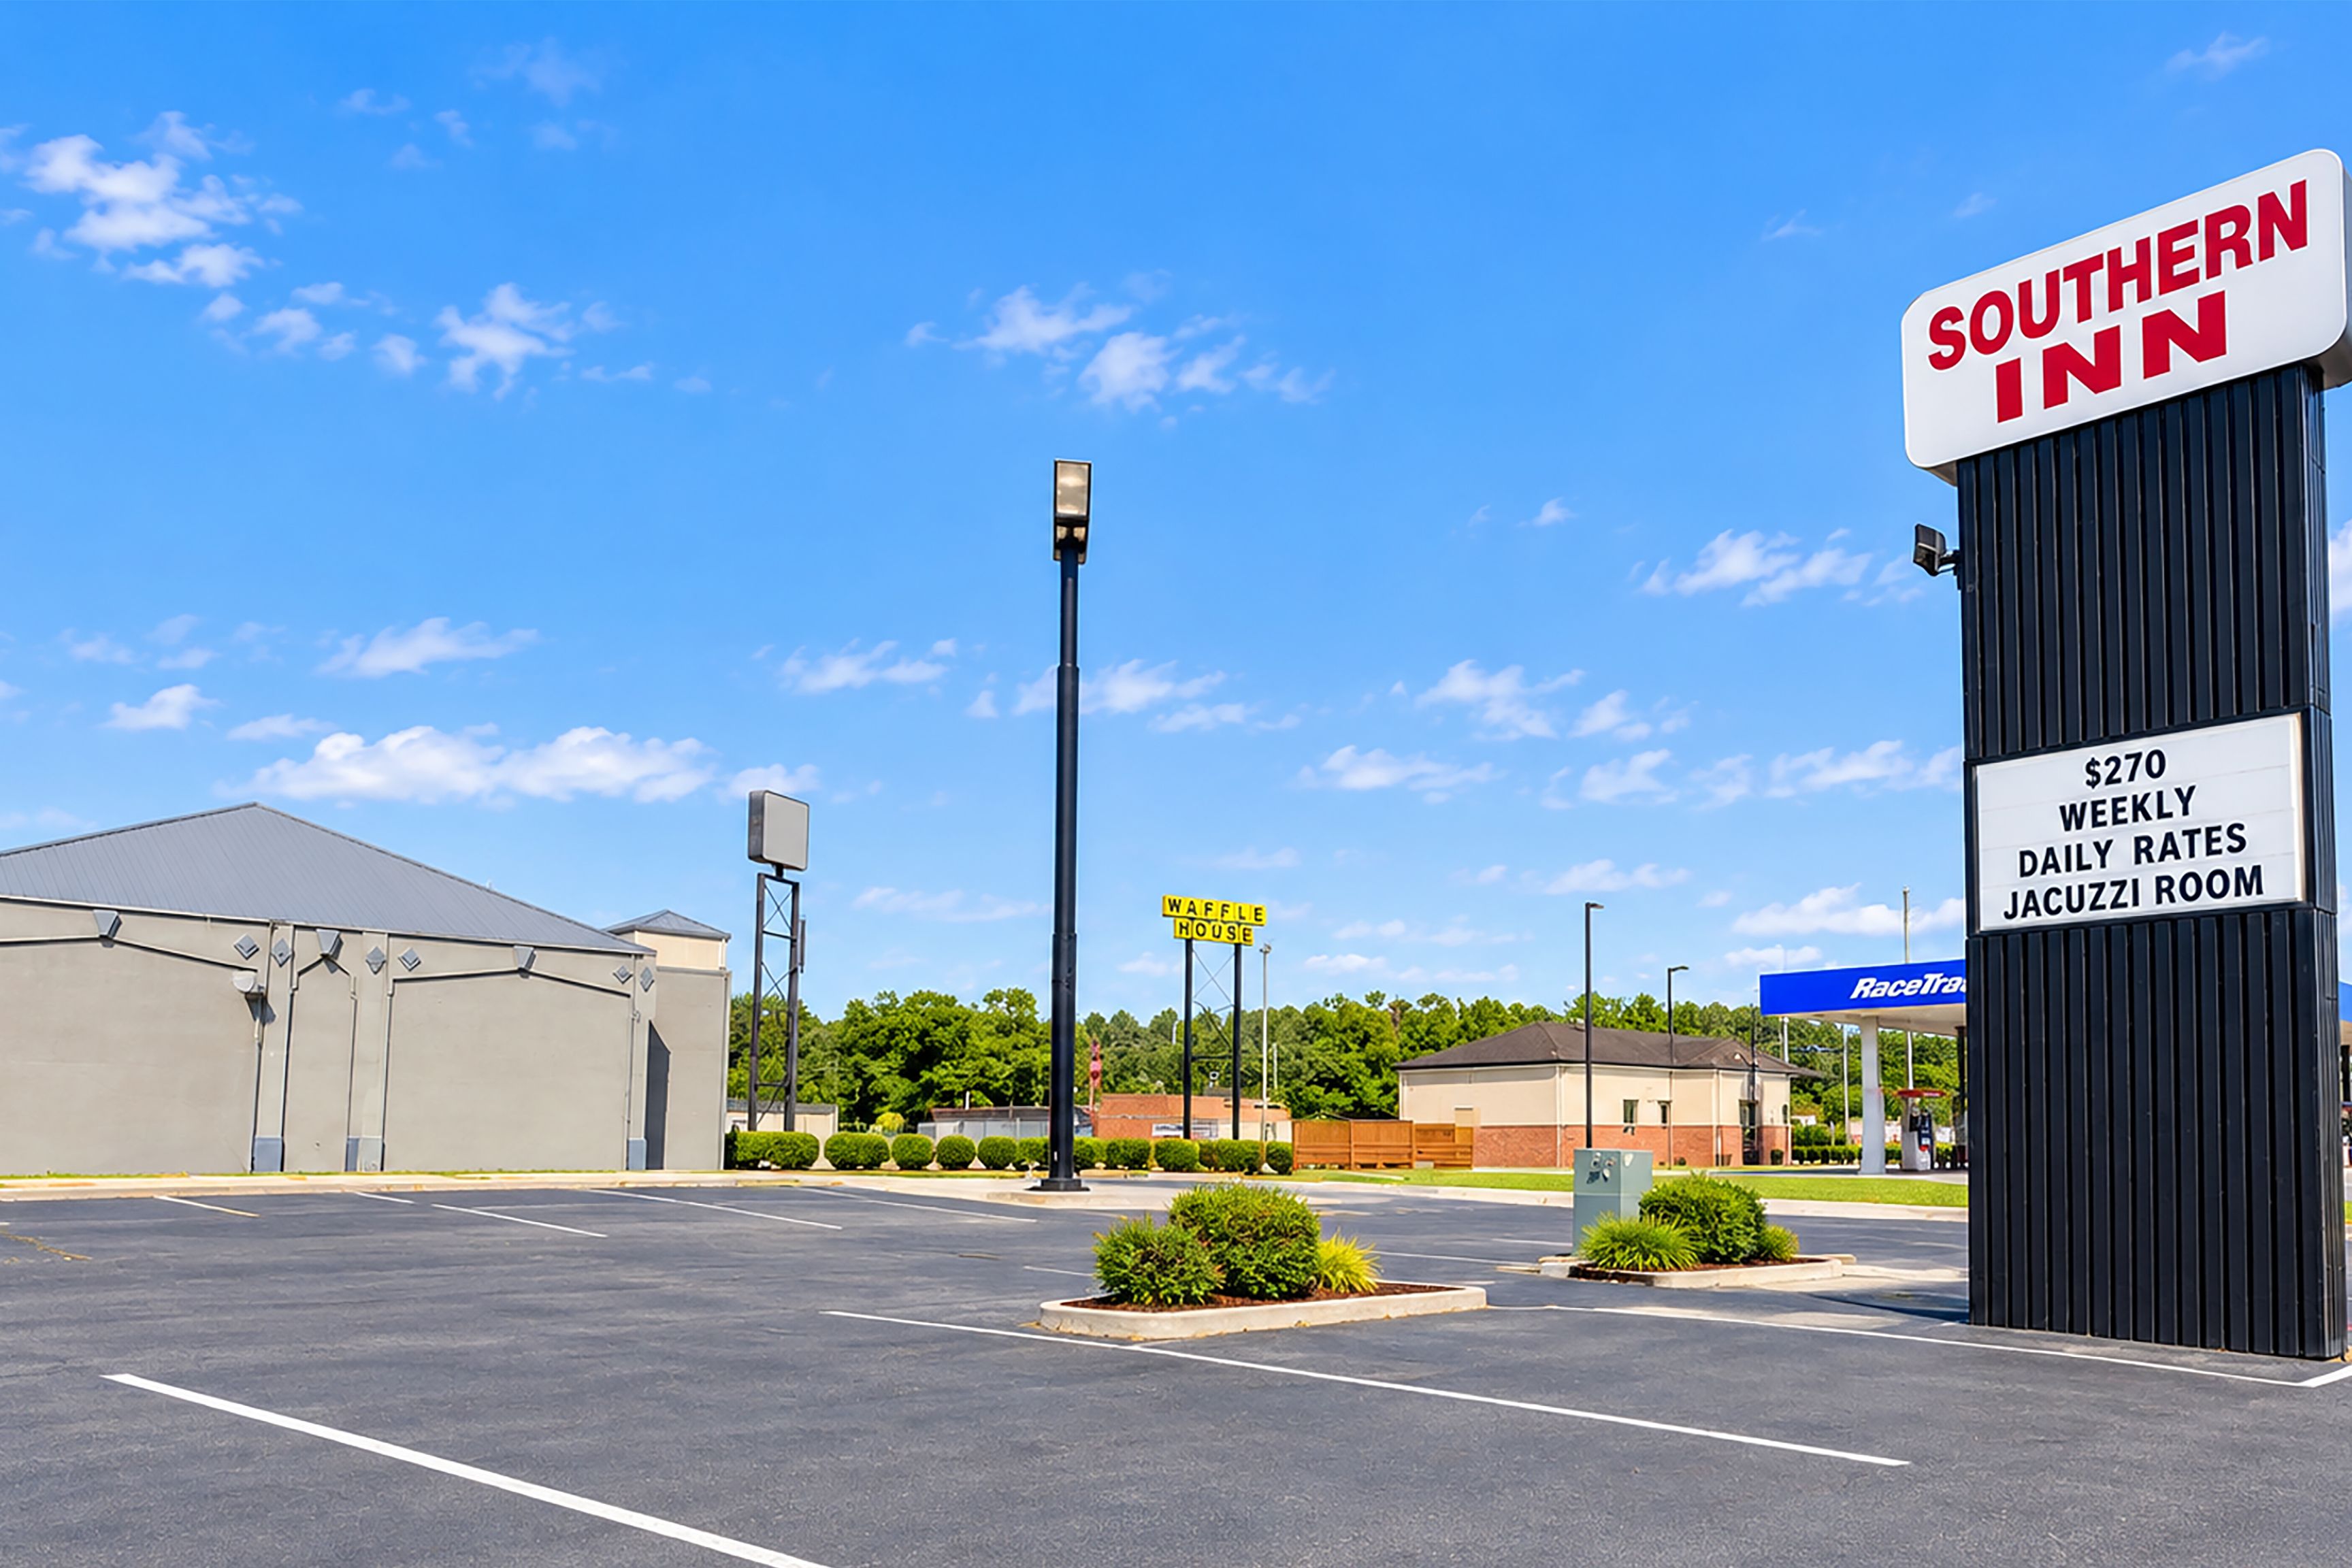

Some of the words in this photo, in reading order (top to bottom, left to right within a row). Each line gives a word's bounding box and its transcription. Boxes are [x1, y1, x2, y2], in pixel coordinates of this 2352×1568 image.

[1927, 178, 2308, 372] SOUTHERN
[1995, 290, 2227, 424] INN
[2085, 749, 2167, 789] $270
[2059, 785, 2197, 832] WEEKLY
[2019, 839, 2114, 879] DAILY
[2134, 823, 2247, 866] RATES
[1168, 898, 1263, 922] WAFFLE
[2004, 878, 2139, 920] JACUZZI
[2155, 864, 2264, 905] ROOM
[1179, 921, 1252, 943] HOUSE
